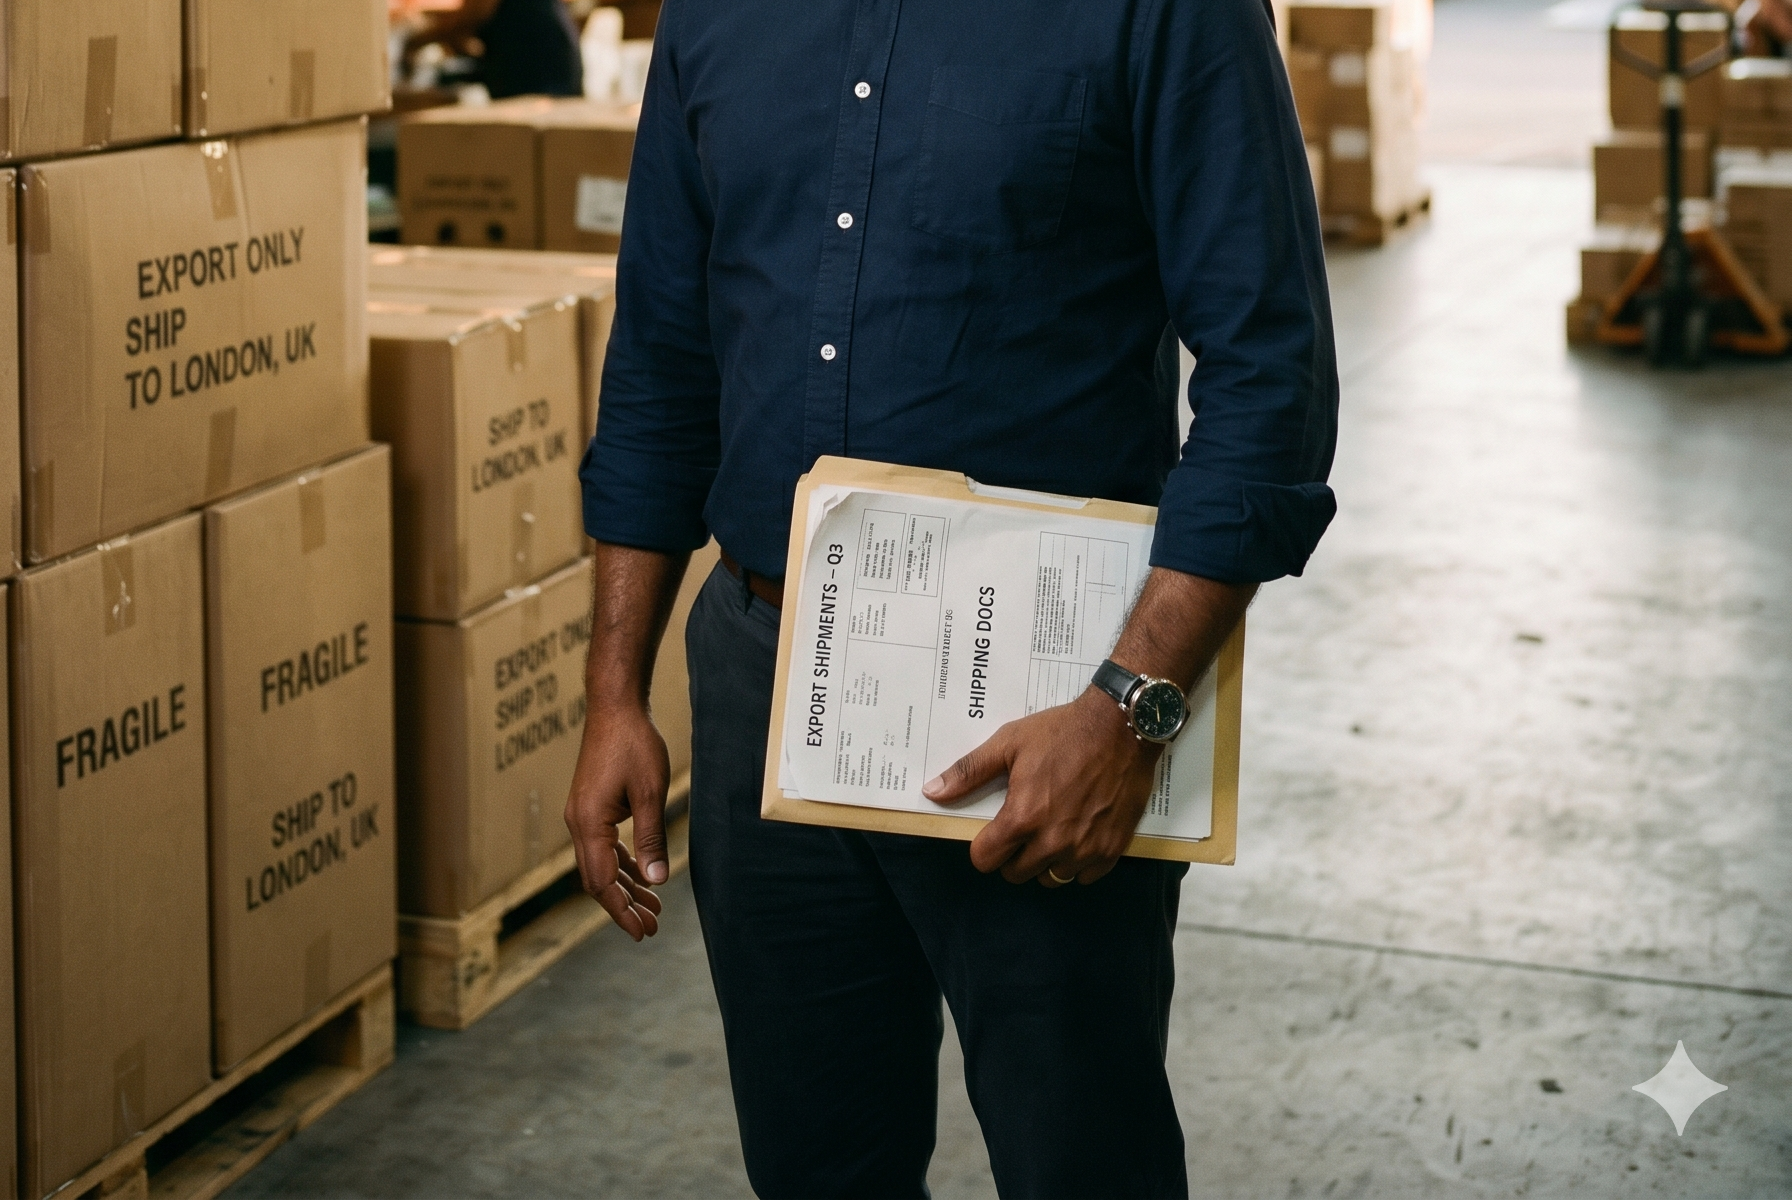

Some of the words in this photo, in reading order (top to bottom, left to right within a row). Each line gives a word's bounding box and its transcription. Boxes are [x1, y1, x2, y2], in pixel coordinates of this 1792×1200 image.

[137, 242, 239, 299] EXPORT
[247, 227, 305, 273] ONLY
[125, 308, 187, 356] SHIP
[125, 366, 162, 409] TO
[170, 335, 279, 398] LONDON,
[286, 323, 318, 364] UK
[488, 407, 524, 446] SHIP
[528, 399, 550, 430] TO
[544, 428, 567, 462] UK
[826, 543, 844, 566] Q3
[813, 583, 838, 678] SHIPMENTS
[976, 585, 995, 632] DOCS
[260, 622, 369, 713] FRAGILE
[494, 630, 558, 690] EXPORT
[968, 637, 991, 719] SHIPPING
[496, 685, 534, 730] SHIP
[535, 673, 558, 707] TO
[806, 682, 828, 748] EXPORT
[56, 683, 187, 789] FRAGILE
[270, 791, 324, 849] SHIP
[329, 771, 357, 815] TO
[350, 803, 380, 849] UK
